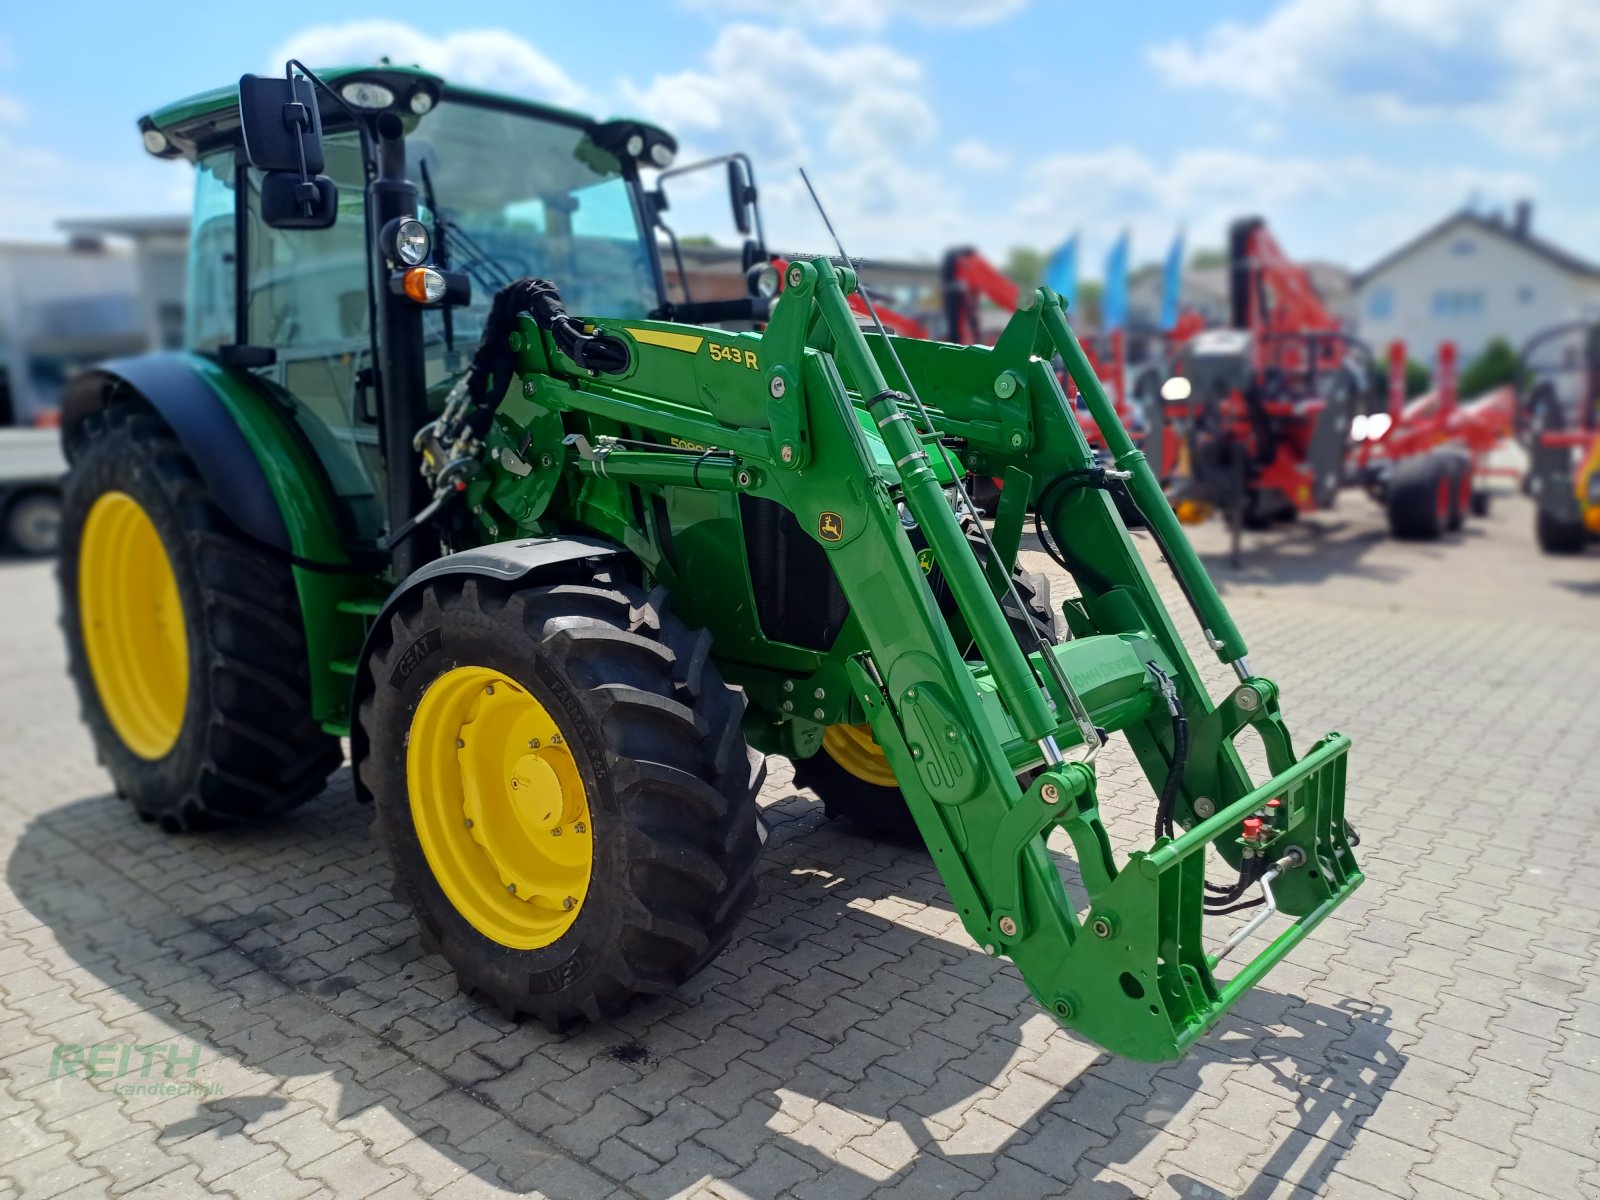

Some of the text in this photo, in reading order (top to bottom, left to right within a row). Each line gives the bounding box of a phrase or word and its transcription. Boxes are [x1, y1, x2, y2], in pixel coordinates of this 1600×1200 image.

[708, 342, 760, 371] 543 R
[400, 636, 429, 676] CEAT
[1072, 666, 1103, 688] OHN
[551, 680, 594, 744] FARMAX
